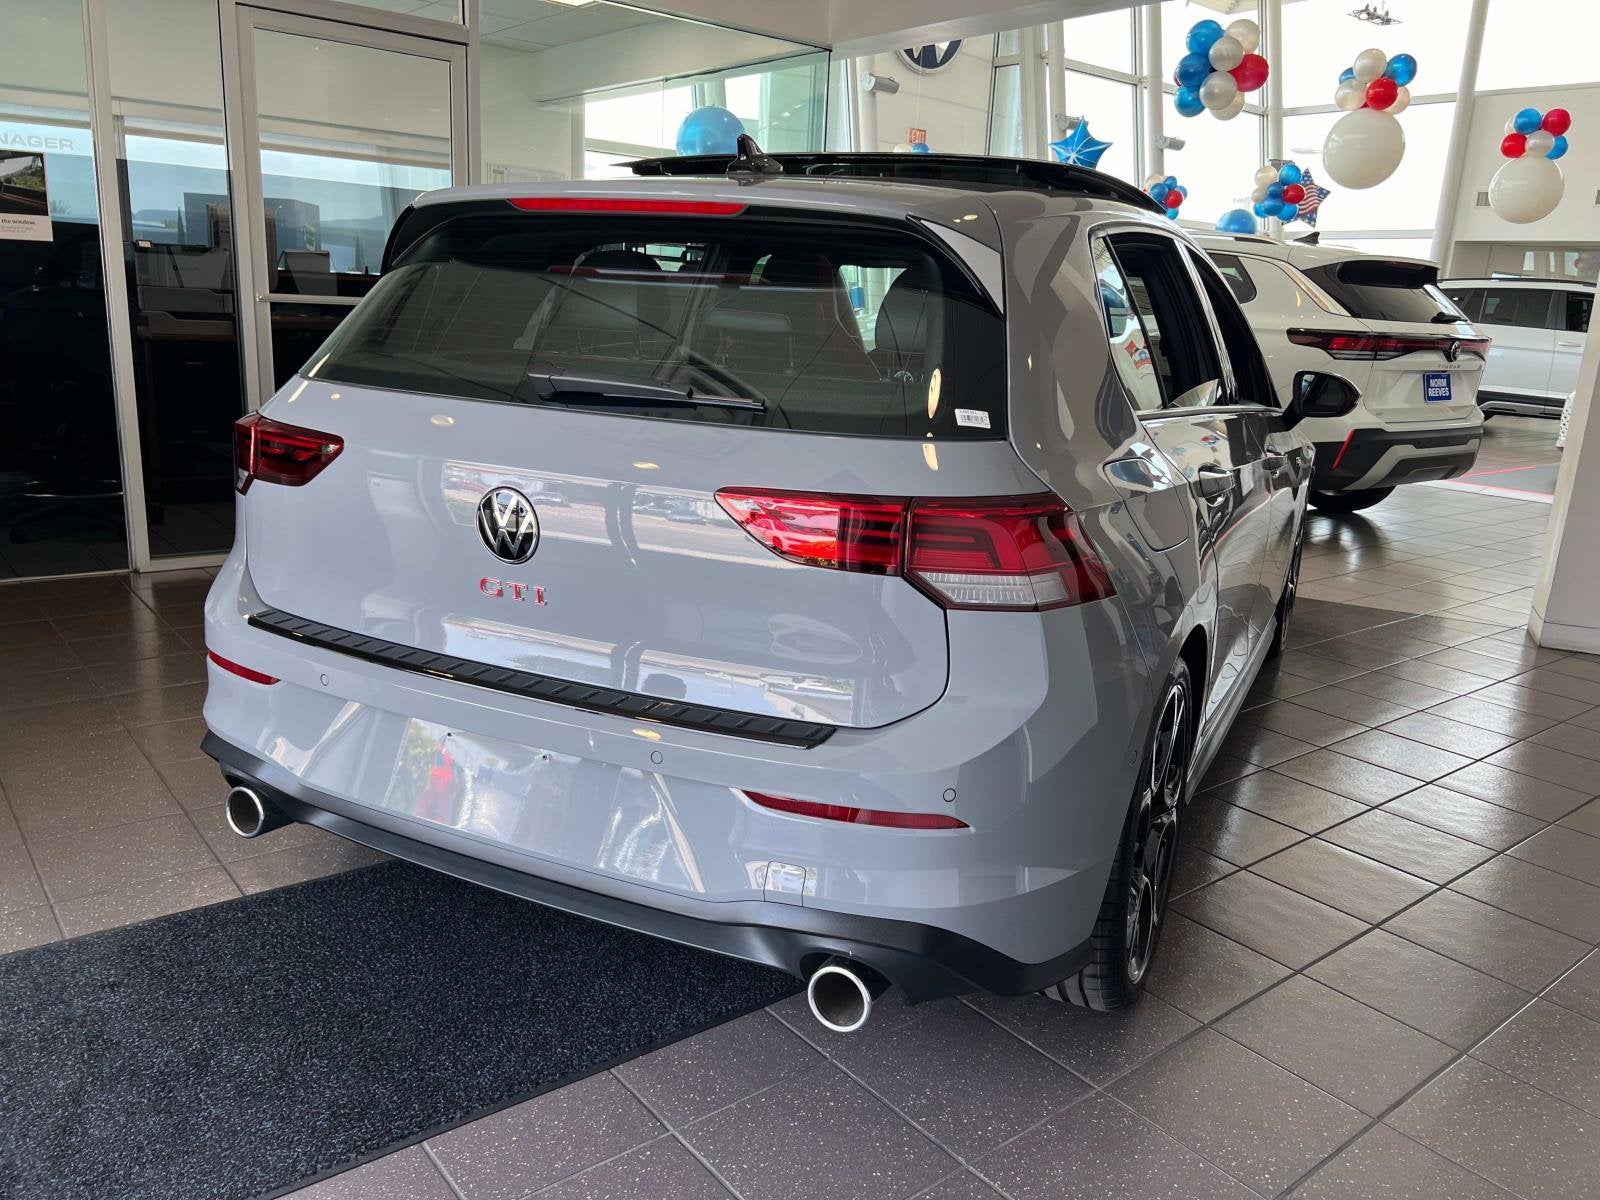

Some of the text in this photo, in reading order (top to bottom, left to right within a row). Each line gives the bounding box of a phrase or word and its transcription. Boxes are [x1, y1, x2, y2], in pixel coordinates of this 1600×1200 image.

[1430, 378, 1447, 387] NORM
[1428, 387, 1450, 397] REEVES
[480, 577, 547, 606] GTI
